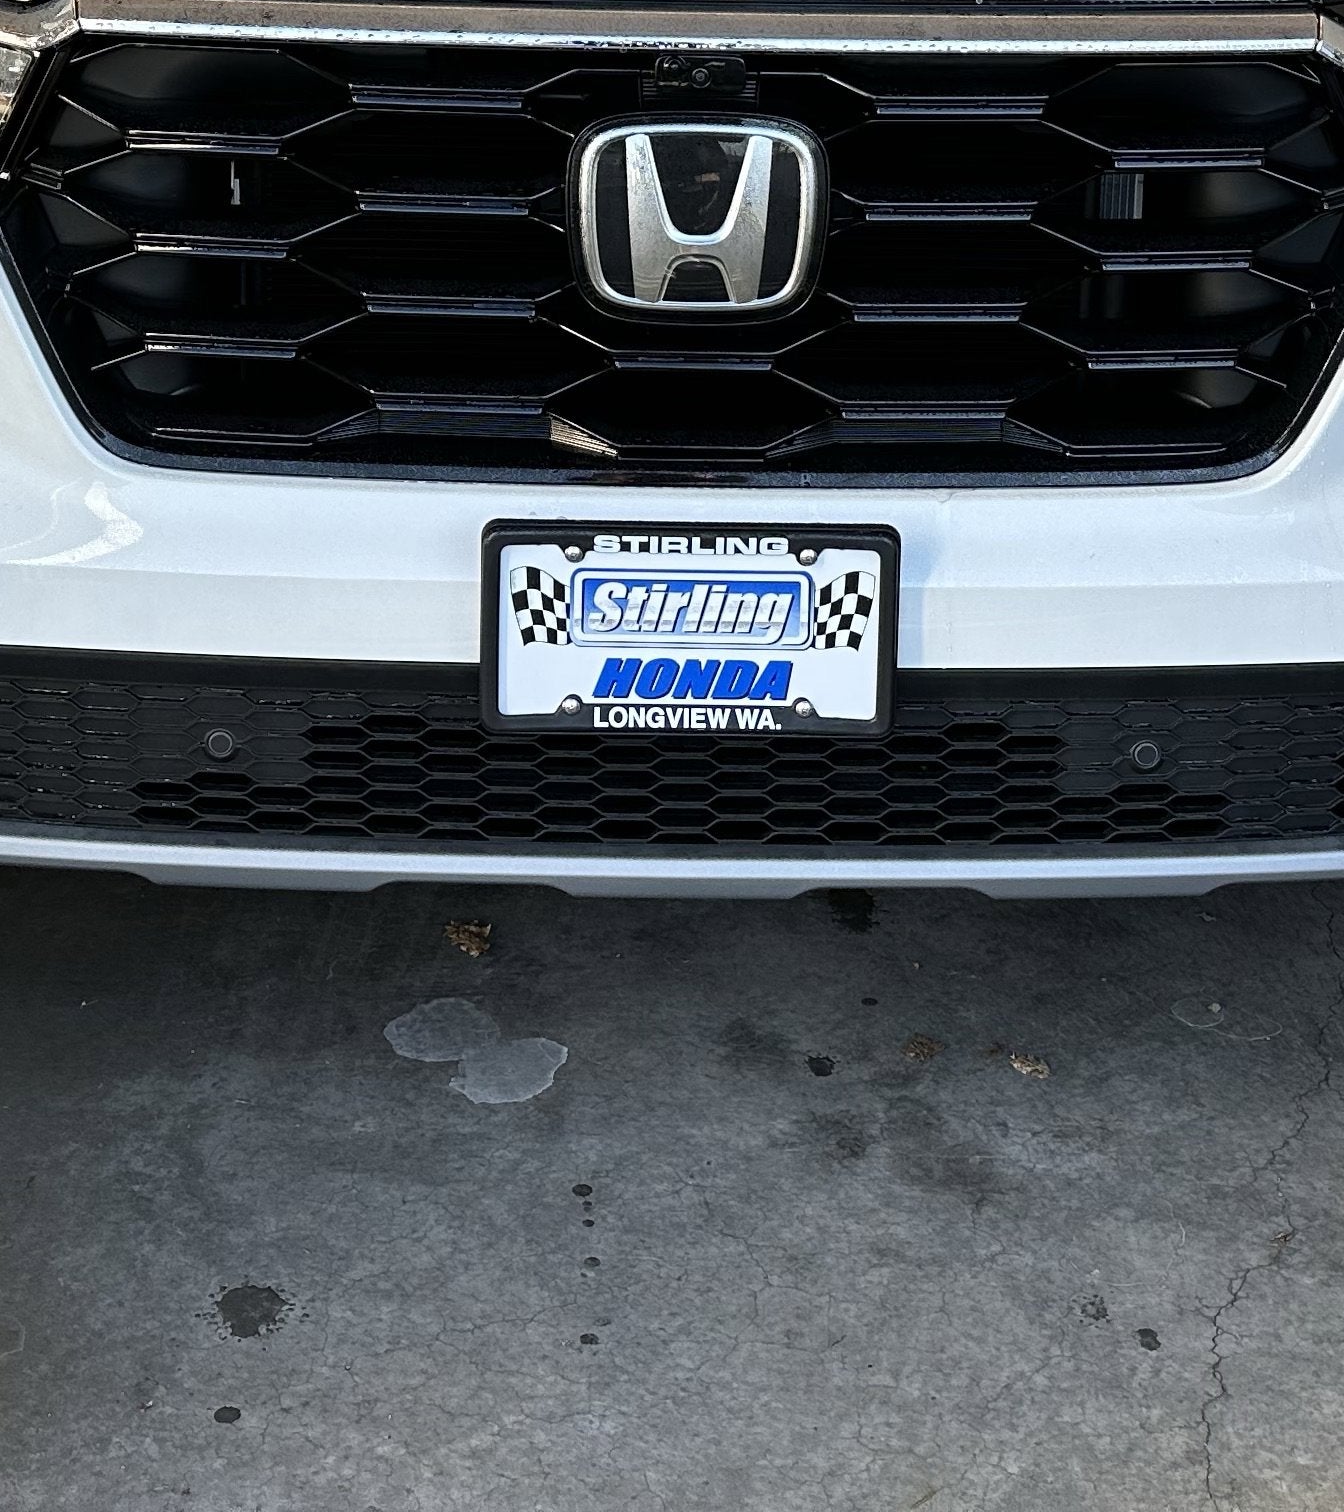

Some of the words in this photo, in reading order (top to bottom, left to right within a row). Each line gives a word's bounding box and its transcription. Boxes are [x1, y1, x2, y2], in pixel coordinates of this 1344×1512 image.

[593, 534, 789, 556] STIRLING
[588, 581, 794, 645] Stirling
[592, 657, 793, 701] HONDA
[593, 706, 730, 730] LONGVIEW
[735, 708, 782, 730] WA.
